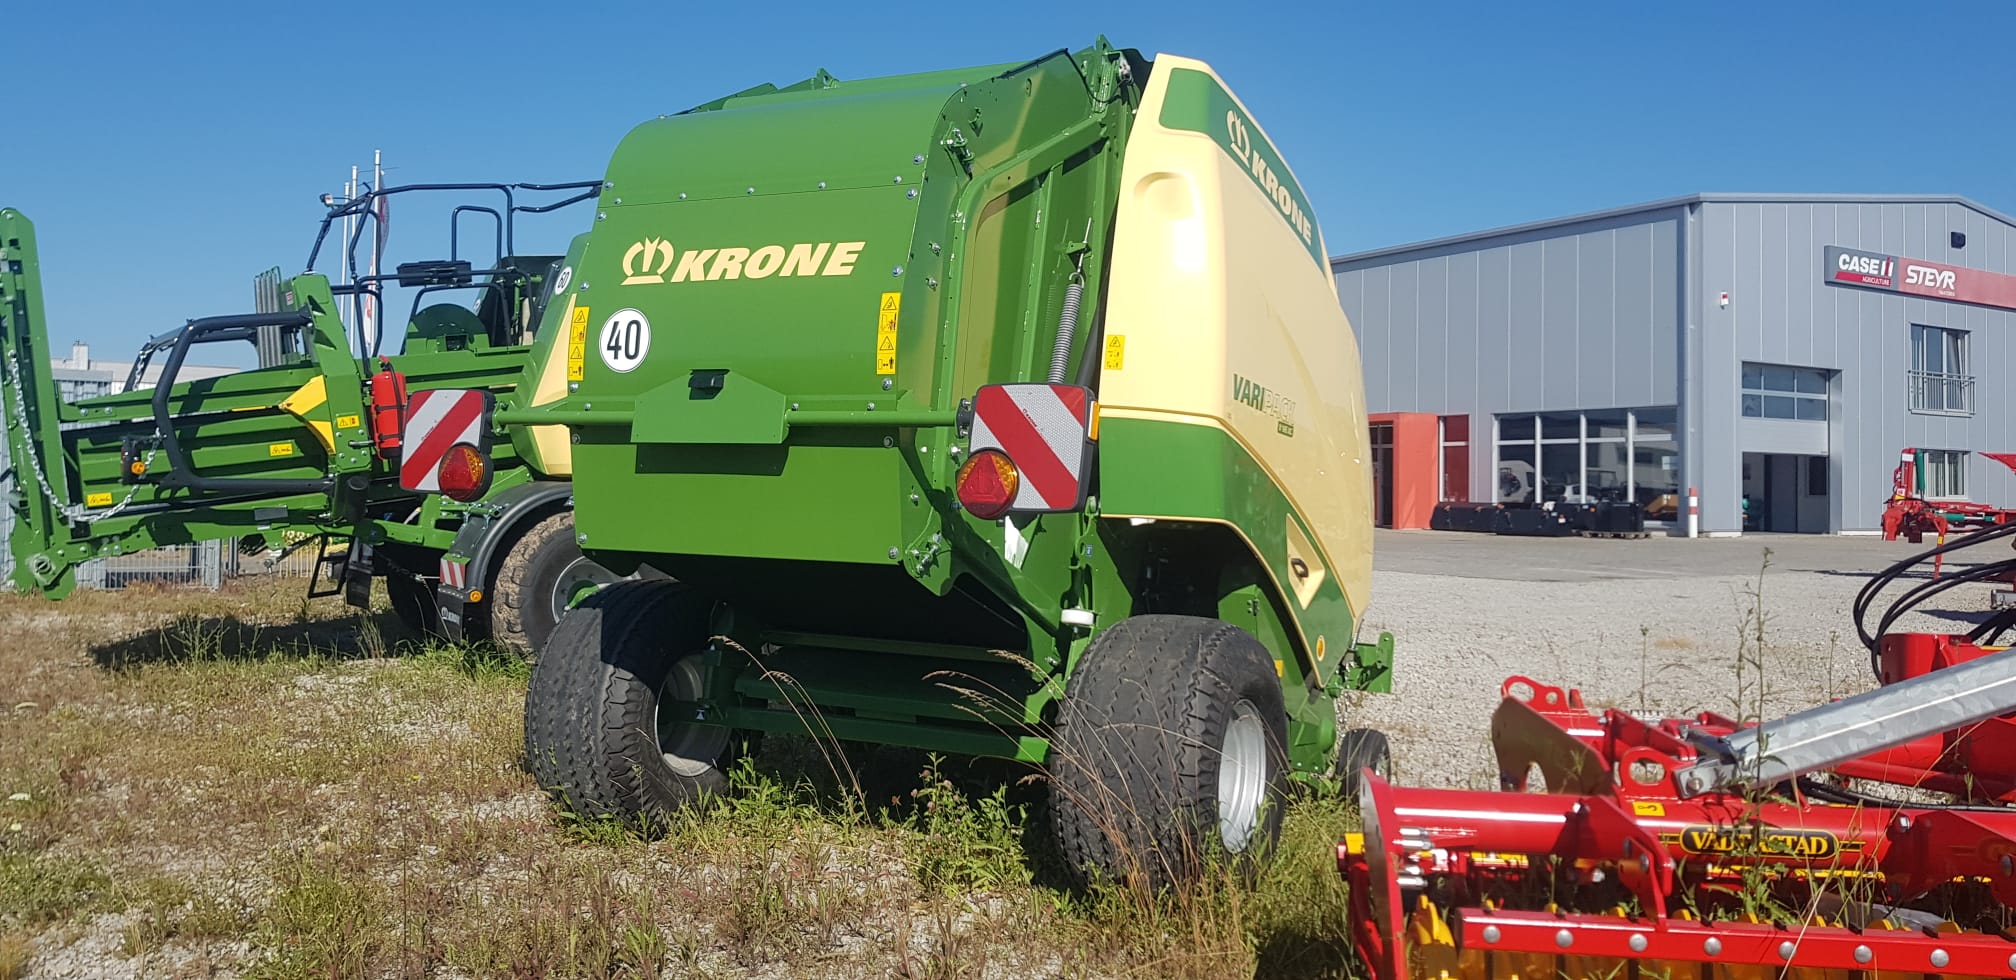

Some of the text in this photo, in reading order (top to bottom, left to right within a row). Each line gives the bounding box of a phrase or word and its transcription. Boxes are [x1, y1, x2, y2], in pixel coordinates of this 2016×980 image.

[1252, 149, 1312, 246] KRONE
[670, 241, 866, 283] KRONE
[1838, 253, 1879, 275] CASE
[1905, 264, 1956, 290] STEYR
[1862, 275, 1890, 286] AGRICULTURE
[606, 319, 642, 360] 40
